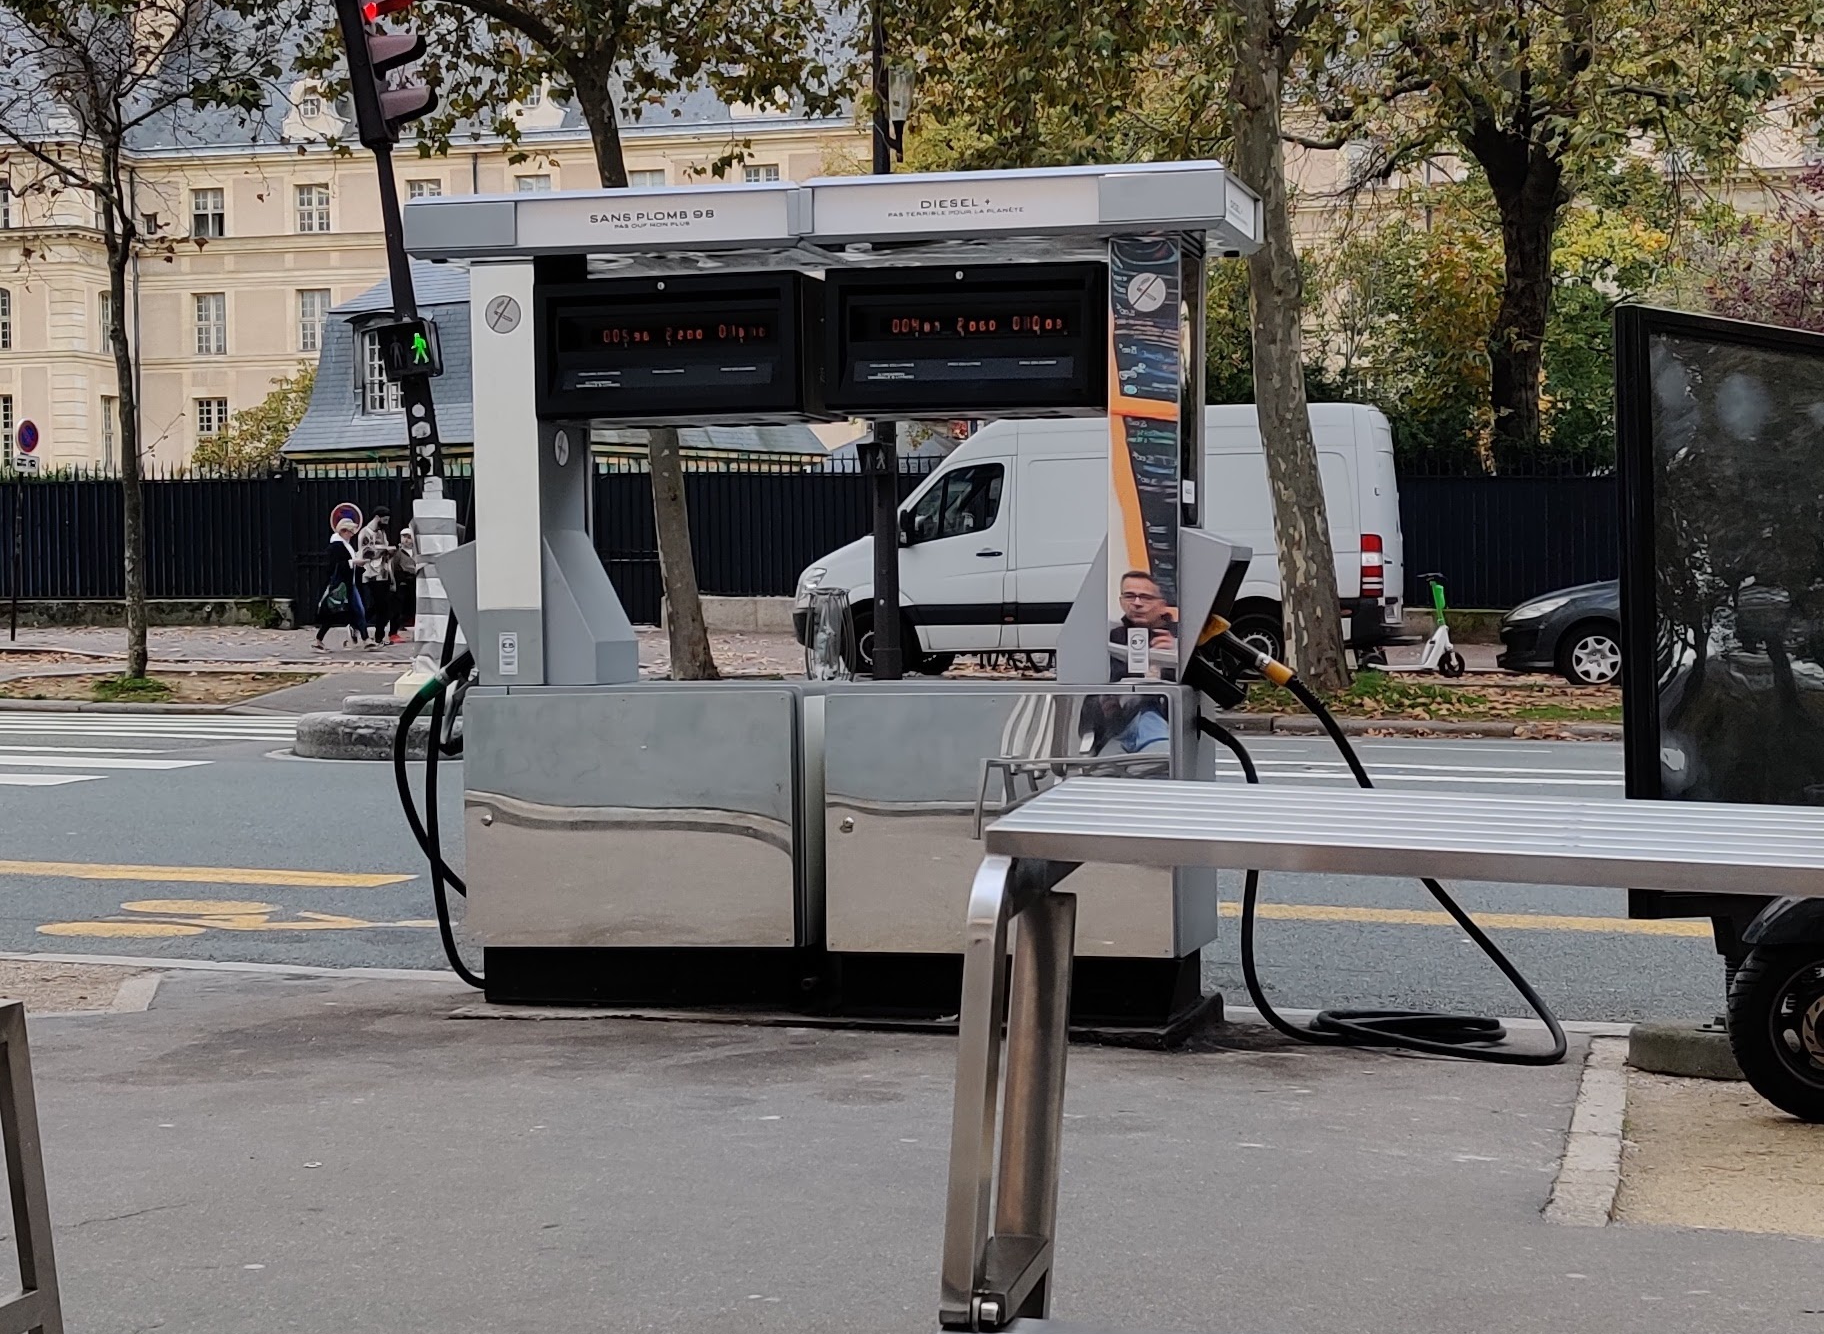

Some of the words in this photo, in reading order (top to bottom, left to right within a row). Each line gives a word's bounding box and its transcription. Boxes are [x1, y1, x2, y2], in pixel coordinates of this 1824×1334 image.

[921, 198, 978, 210] DIESEL
[590, 212, 632, 224] SANS
[636, 210, 688, 222] PLOMB
[693, 209, 715, 219] 98
